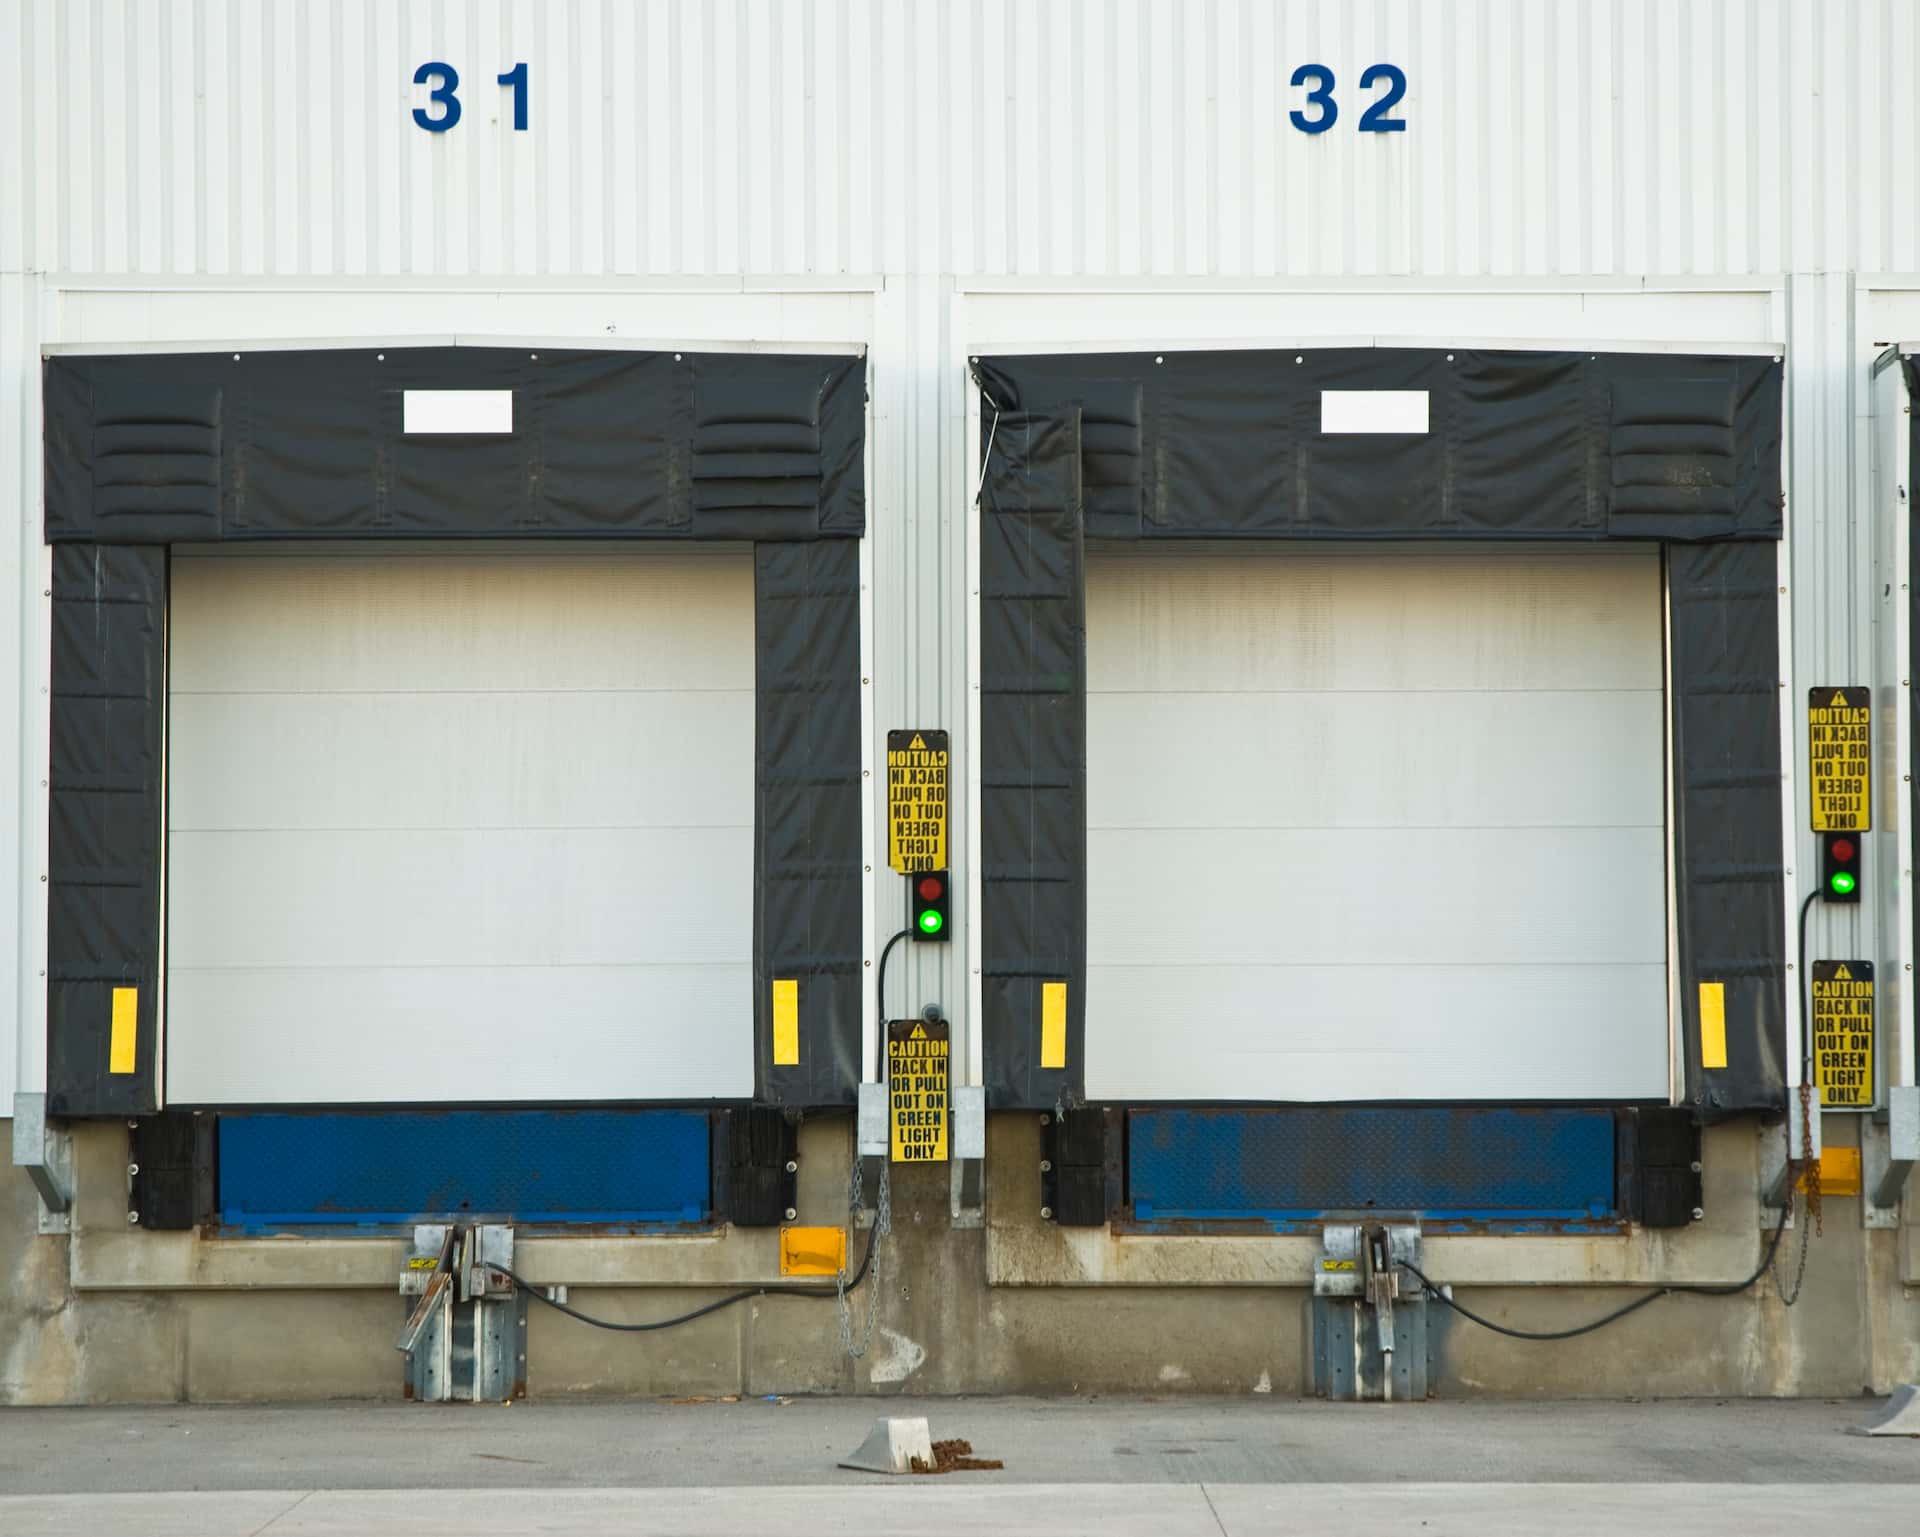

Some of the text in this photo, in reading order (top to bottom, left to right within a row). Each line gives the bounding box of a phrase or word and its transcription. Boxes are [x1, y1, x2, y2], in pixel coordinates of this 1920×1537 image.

[1289, 63, 1407, 133] 32
[1813, 981, 1873, 997] CAUTION
[1816, 1000, 1871, 1015] BACK IN
[1816, 1017, 1871, 1032] OR PULL
[889, 1040, 949, 1056] CAUTION
[1818, 1035, 1869, 1050] OUT ON
[1822, 1052, 1865, 1067] GREEN
[892, 1060, 945, 1075] BACK IN
[892, 1077, 945, 1092] OR PULL
[1823, 1070, 1865, 1085] LIGHT
[894, 1094, 944, 1109] OUT ON
[1828, 1087, 1860, 1102] ONLY
[898, 1111, 941, 1126] GREEN
[899, 1128, 940, 1143] LIGHT
[904, 1145, 935, 1159] ONLY
